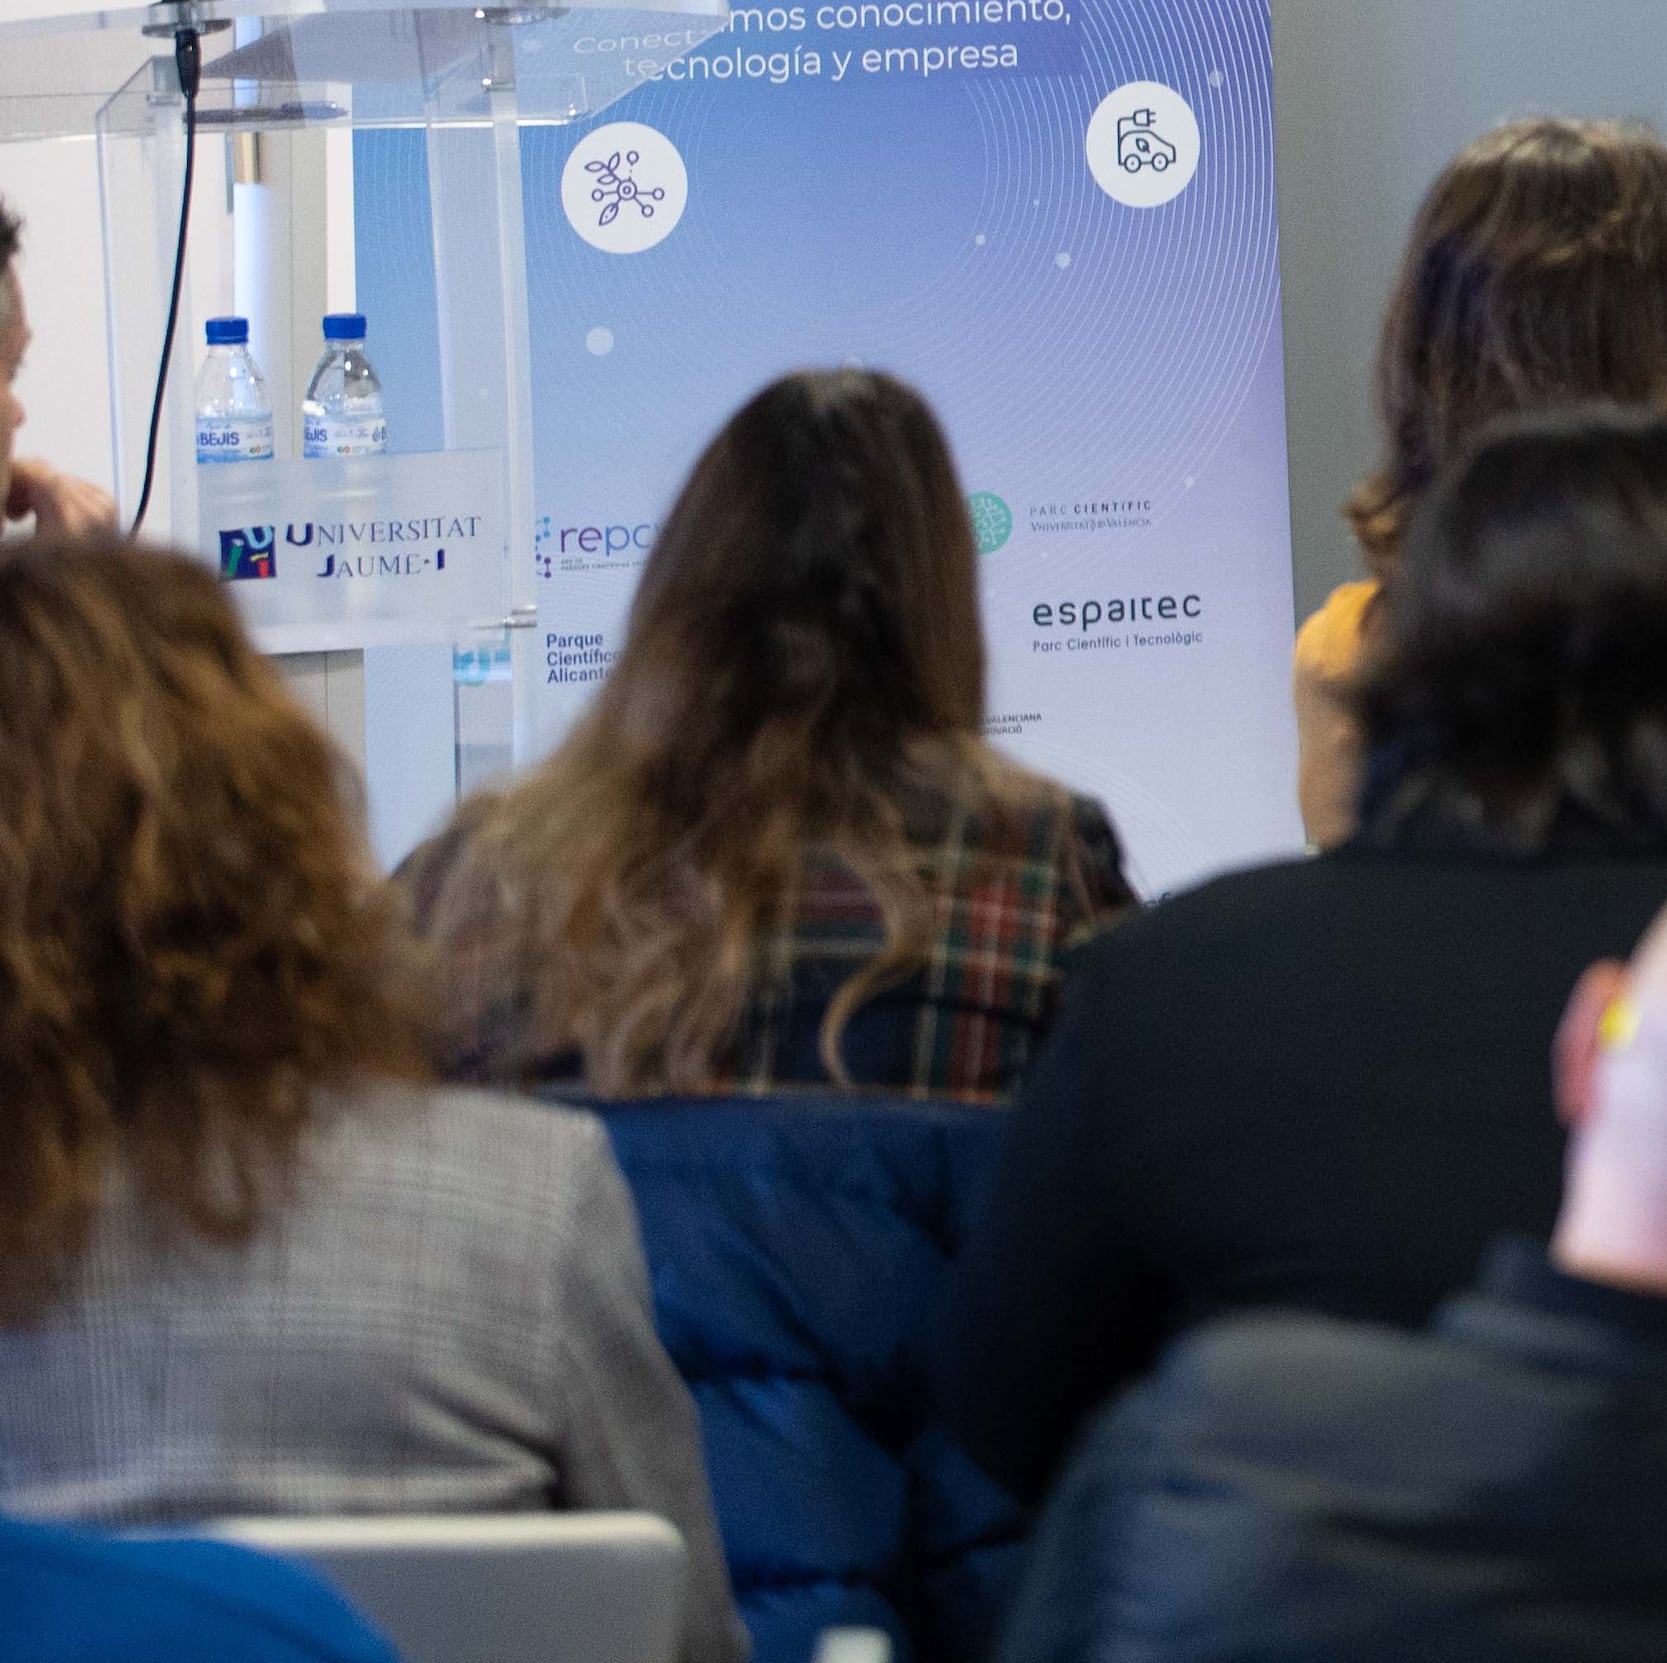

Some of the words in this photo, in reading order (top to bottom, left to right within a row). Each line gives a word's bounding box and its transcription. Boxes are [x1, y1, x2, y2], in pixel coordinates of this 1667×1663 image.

[623, 44, 823, 85] tecnología
[832, 50, 851, 82] y
[861, 43, 1019, 78] empresa
[1029, 504, 1068, 517] PARC
[286, 516, 481, 547] UNIVERSITAT
[560, 523, 652, 557] repc
[1033, 594, 1202, 633] espaitec
[546, 634, 604, 650] Parque
[1033, 639, 1062, 652] Parc
[1134, 630, 1203, 648] Tecnològic
